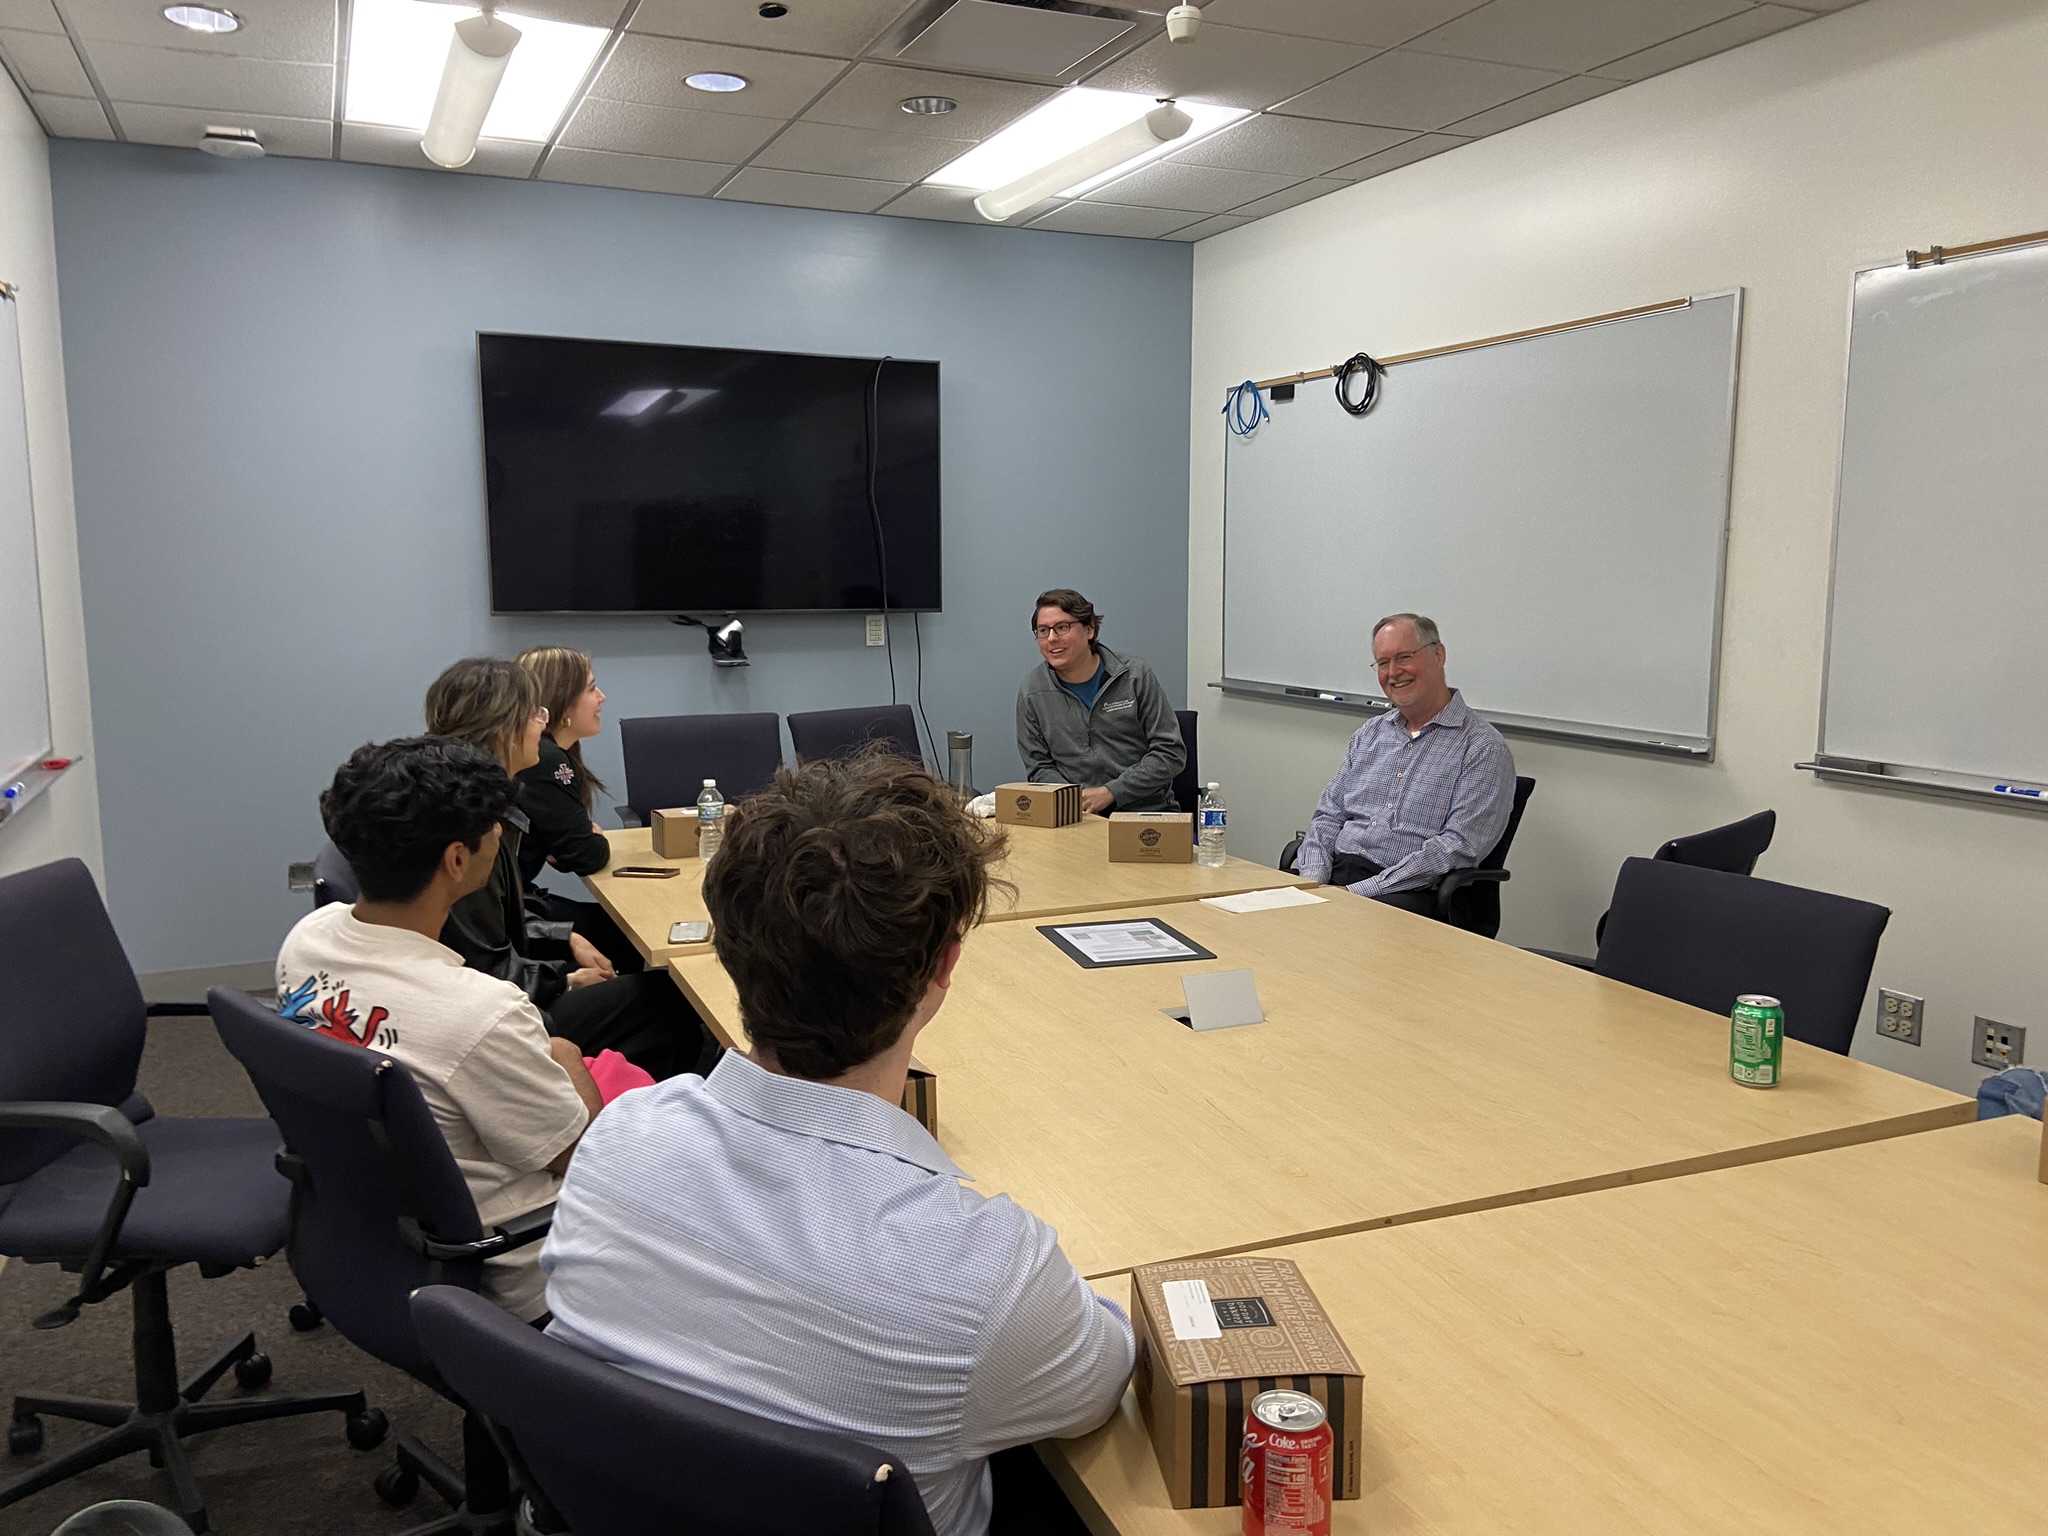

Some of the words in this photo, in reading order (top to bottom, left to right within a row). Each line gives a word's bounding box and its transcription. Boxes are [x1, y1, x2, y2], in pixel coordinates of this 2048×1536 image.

[1140, 1260, 1248, 1275] INSPIRATION
[1250, 1259, 1287, 1296] LUNCH
[1274, 1260, 1321, 1321] CRAVEABLE
[1227, 1302, 1243, 1324] bakery
[1236, 1301, 1253, 1324] corner
[1275, 1296, 1302, 1321] MADE
[1292, 1320, 1331, 1371] PREPARED
[1269, 1433, 1295, 1449] Coke
